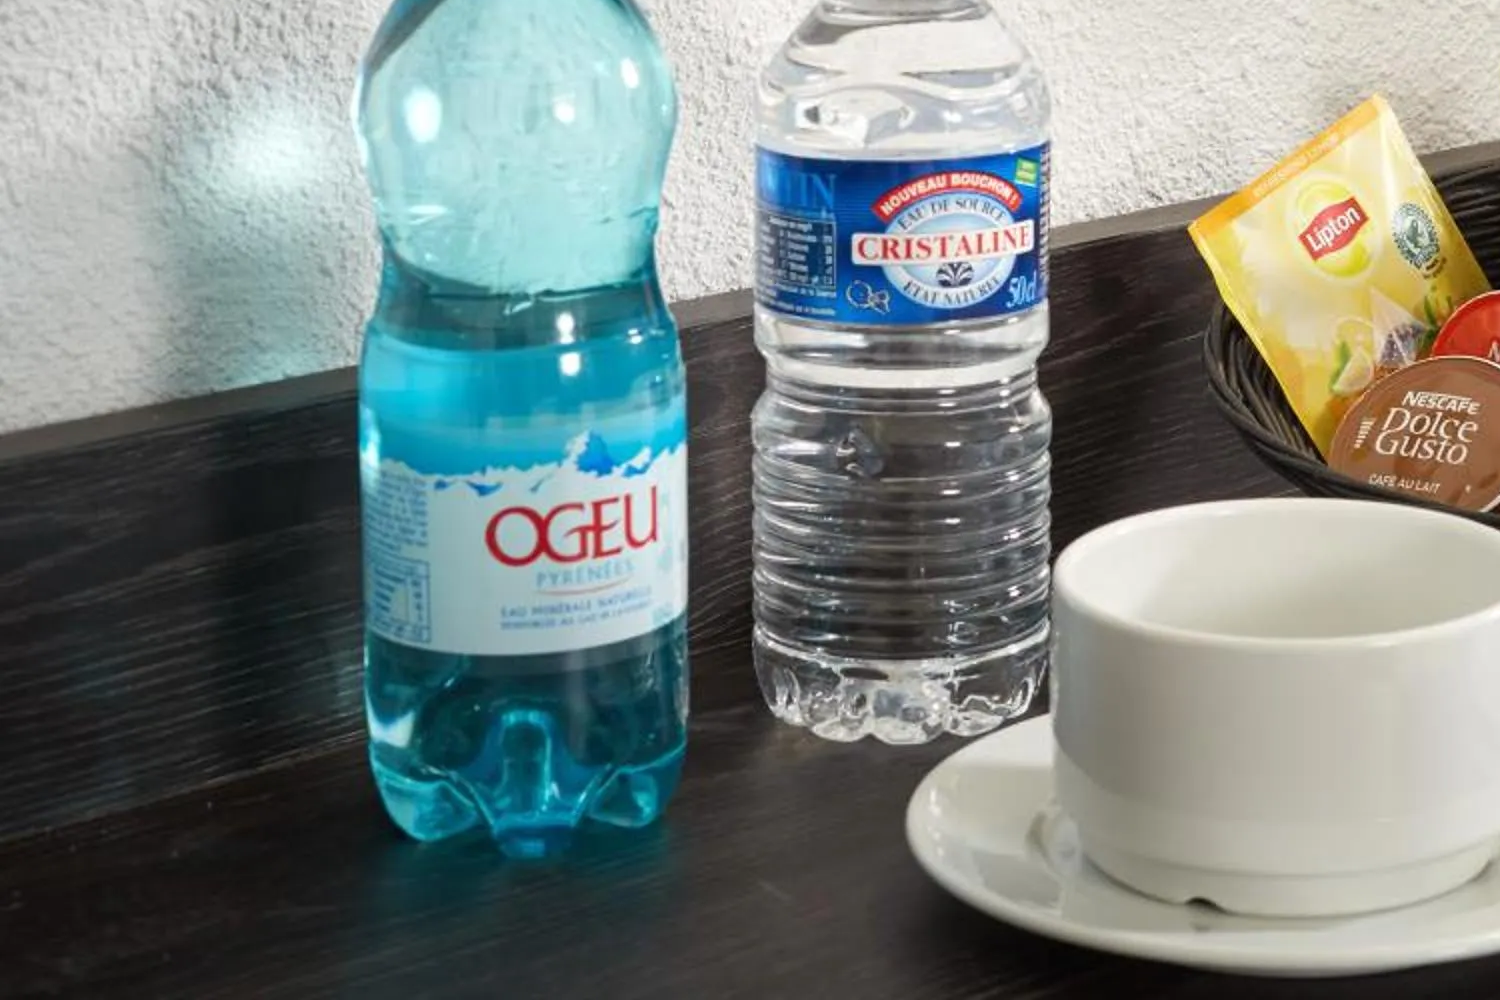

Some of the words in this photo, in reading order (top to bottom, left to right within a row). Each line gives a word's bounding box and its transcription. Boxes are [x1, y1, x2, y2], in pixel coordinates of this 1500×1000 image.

[880, 174, 947, 216] NOUVEAU
[897, 205, 923, 231] EAU
[930, 199, 949, 215] DE
[955, 198, 1006, 221] SOURCE
[1305, 205, 1362, 252] Lipton
[857, 224, 1030, 261] CRISTALINE
[1381, 407, 1479, 443] Dolce
[1375, 429, 1468, 465] Gusto
[1397, 477, 1415, 489] AU
[1415, 479, 1441, 494] LAIT
[484, 485, 658, 568] OGEU
